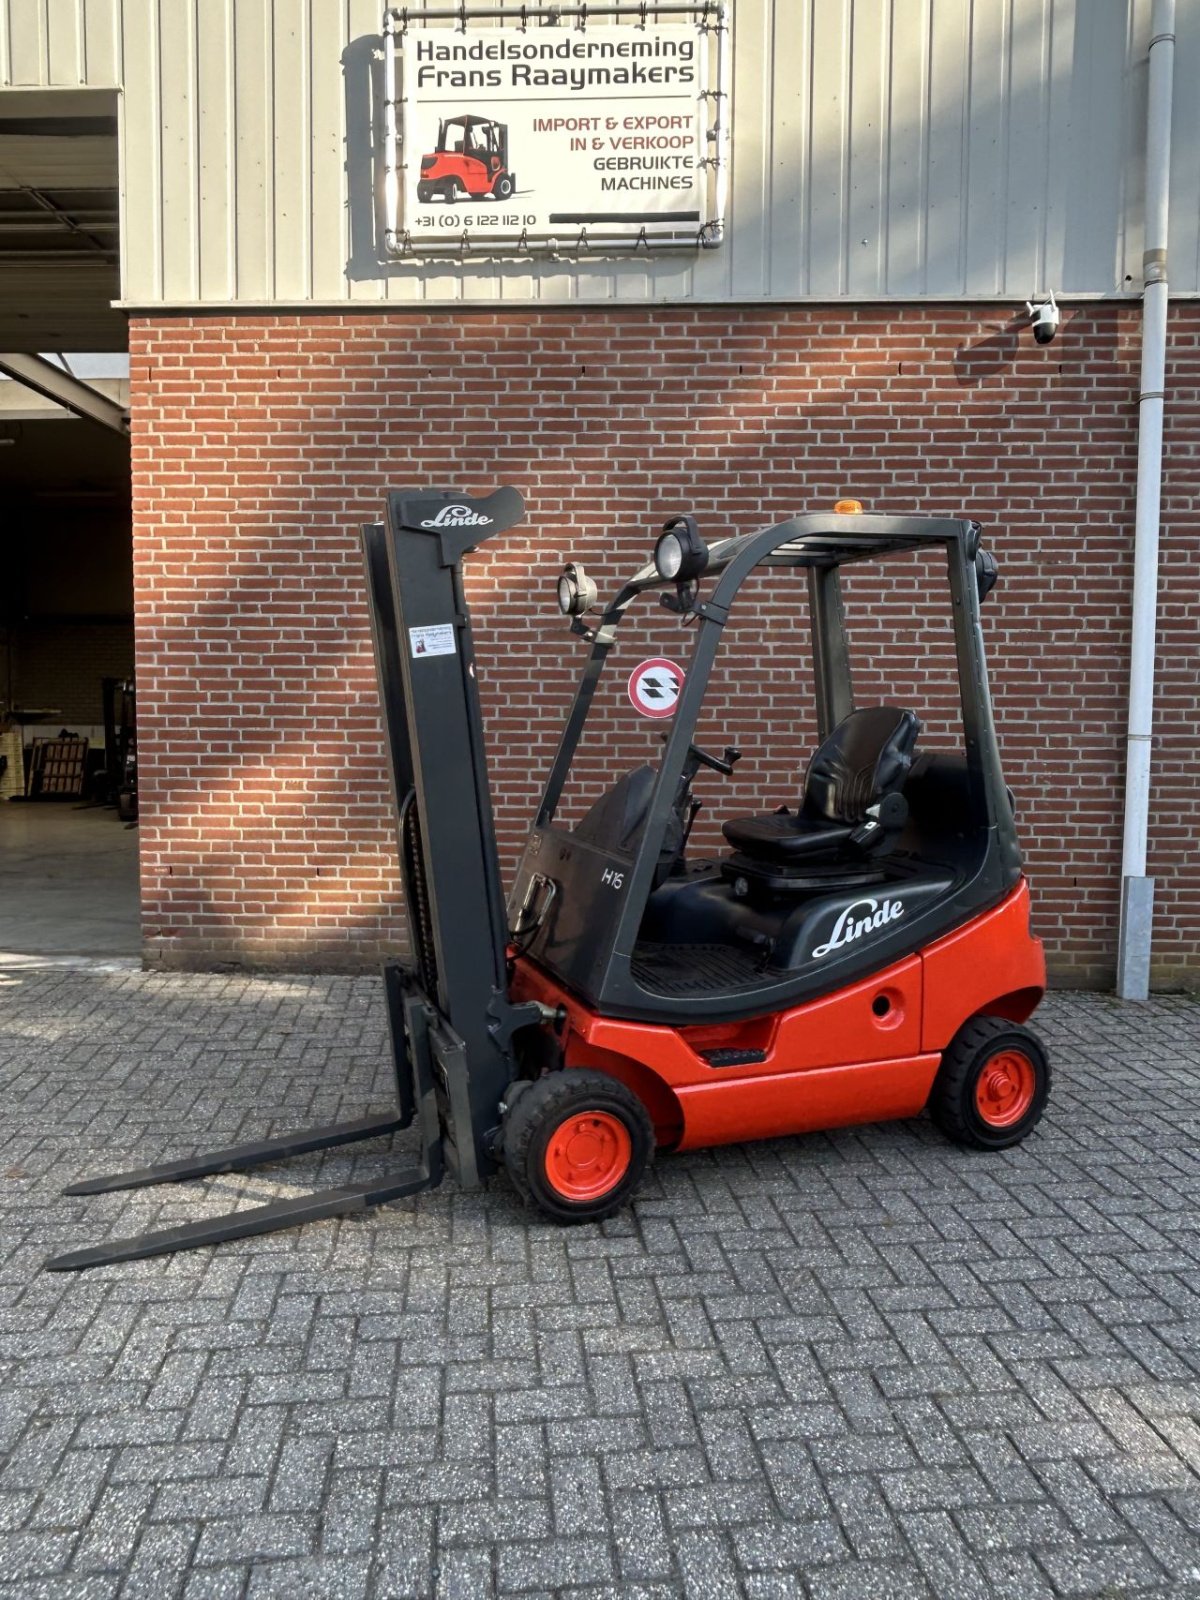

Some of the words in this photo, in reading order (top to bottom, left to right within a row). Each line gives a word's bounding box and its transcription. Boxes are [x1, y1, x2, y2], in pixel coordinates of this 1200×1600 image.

[417, 36, 694, 61] Handelsonderneming
[417, 65, 501, 88] Frans
[512, 62, 694, 90] Raaymakers
[533, 117, 601, 132] IMPORT
[605, 116, 618, 130] &
[624, 115, 693, 130] EXPORT
[570, 138, 587, 151] IN
[592, 138, 604, 151] &
[610, 136, 693, 150] VERKOOP
[594, 156, 693, 171] GEBRUIKTE
[601, 176, 693, 191] MACHINES
[415, 216, 435, 227] +31
[439, 215, 460, 227] (0)
[464, 215, 473, 226] 6
[477, 215, 499, 226] 122
[502, 215, 519, 226] 112
[523, 215, 536, 226] 10
[421, 505, 493, 527] Linde
[601, 868, 624, 890] H16
[812, 898, 905, 958] Linde
